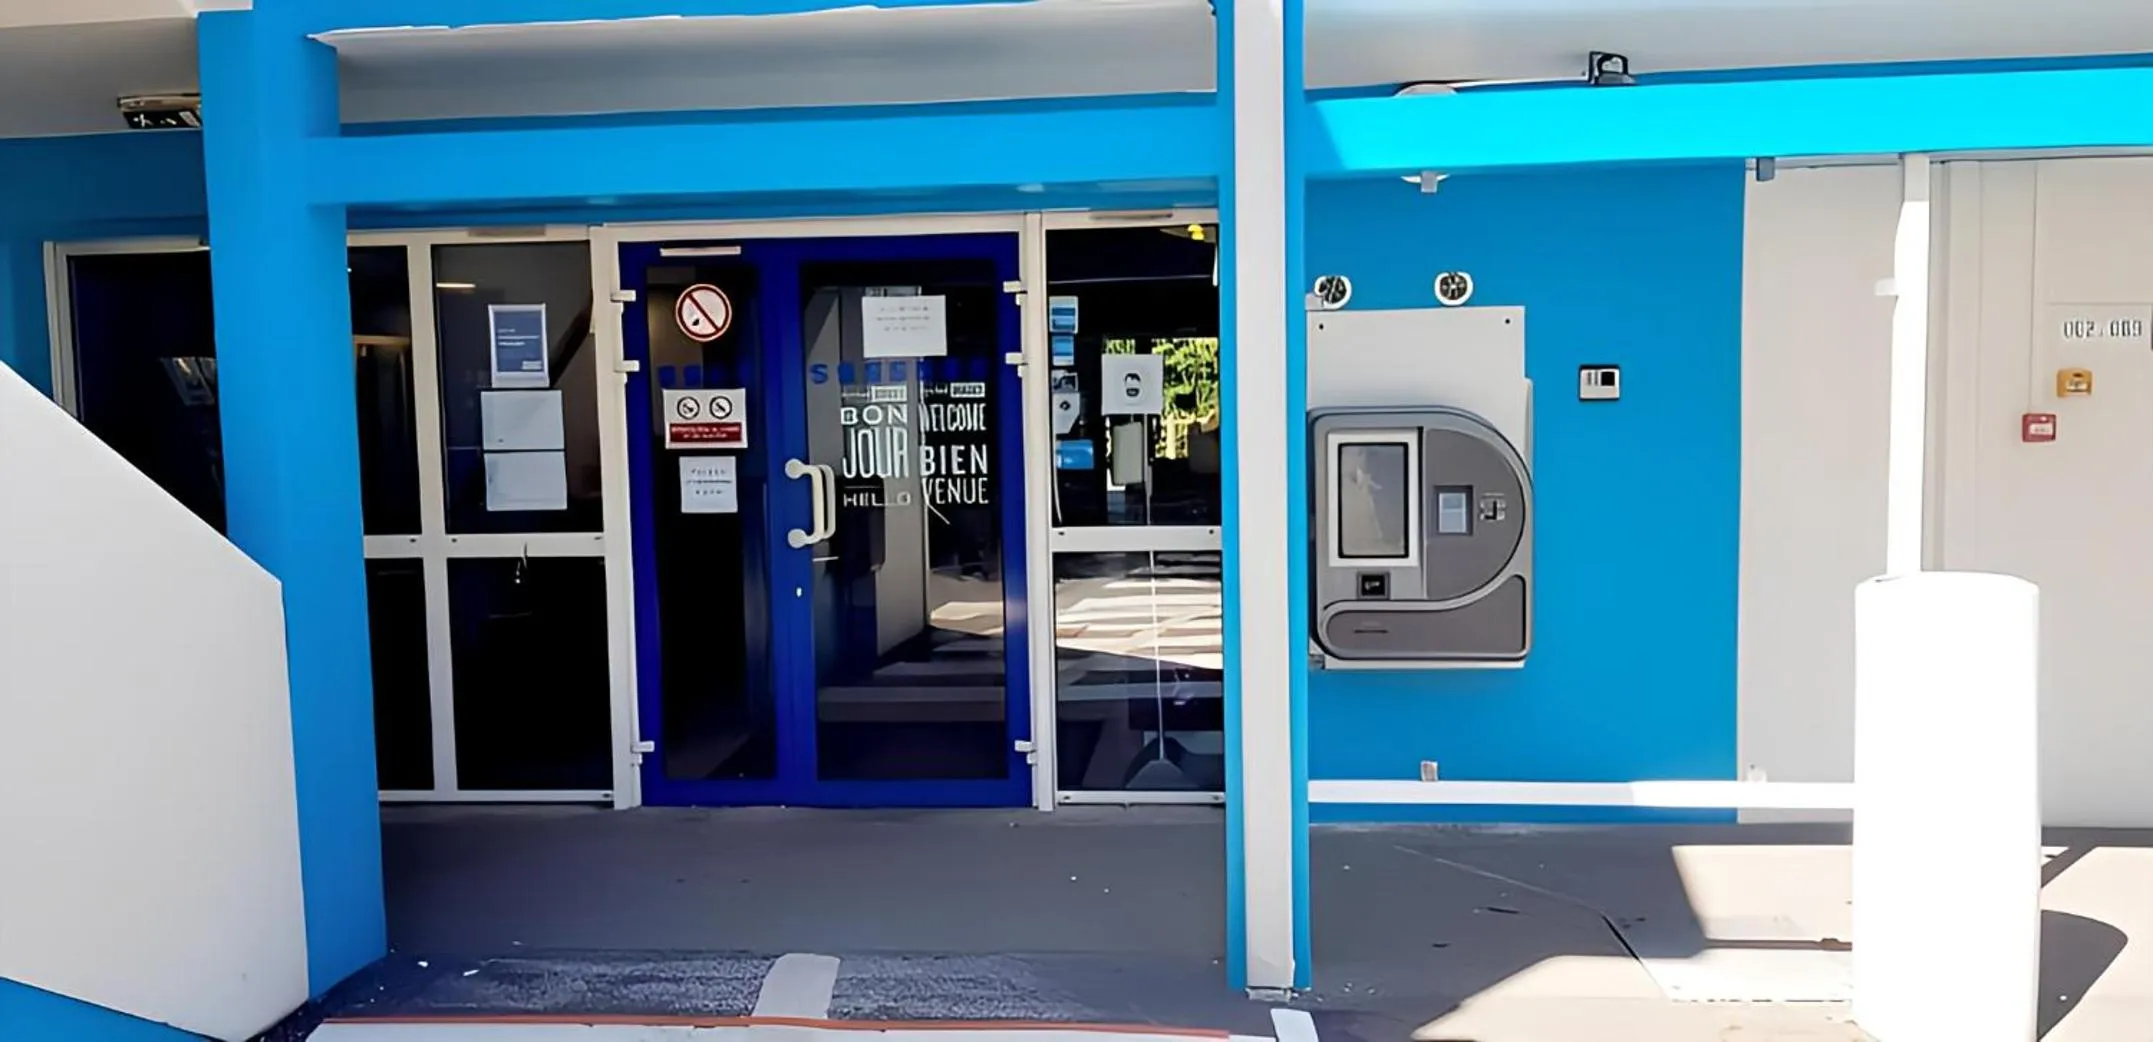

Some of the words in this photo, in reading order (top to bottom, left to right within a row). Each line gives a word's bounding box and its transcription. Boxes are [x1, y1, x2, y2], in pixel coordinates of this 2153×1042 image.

[840, 404, 908, 425] BON
[842, 427, 909, 479] JOUR
[919, 444, 988, 476] BIEN
[921, 476, 989, 505] VENUE
